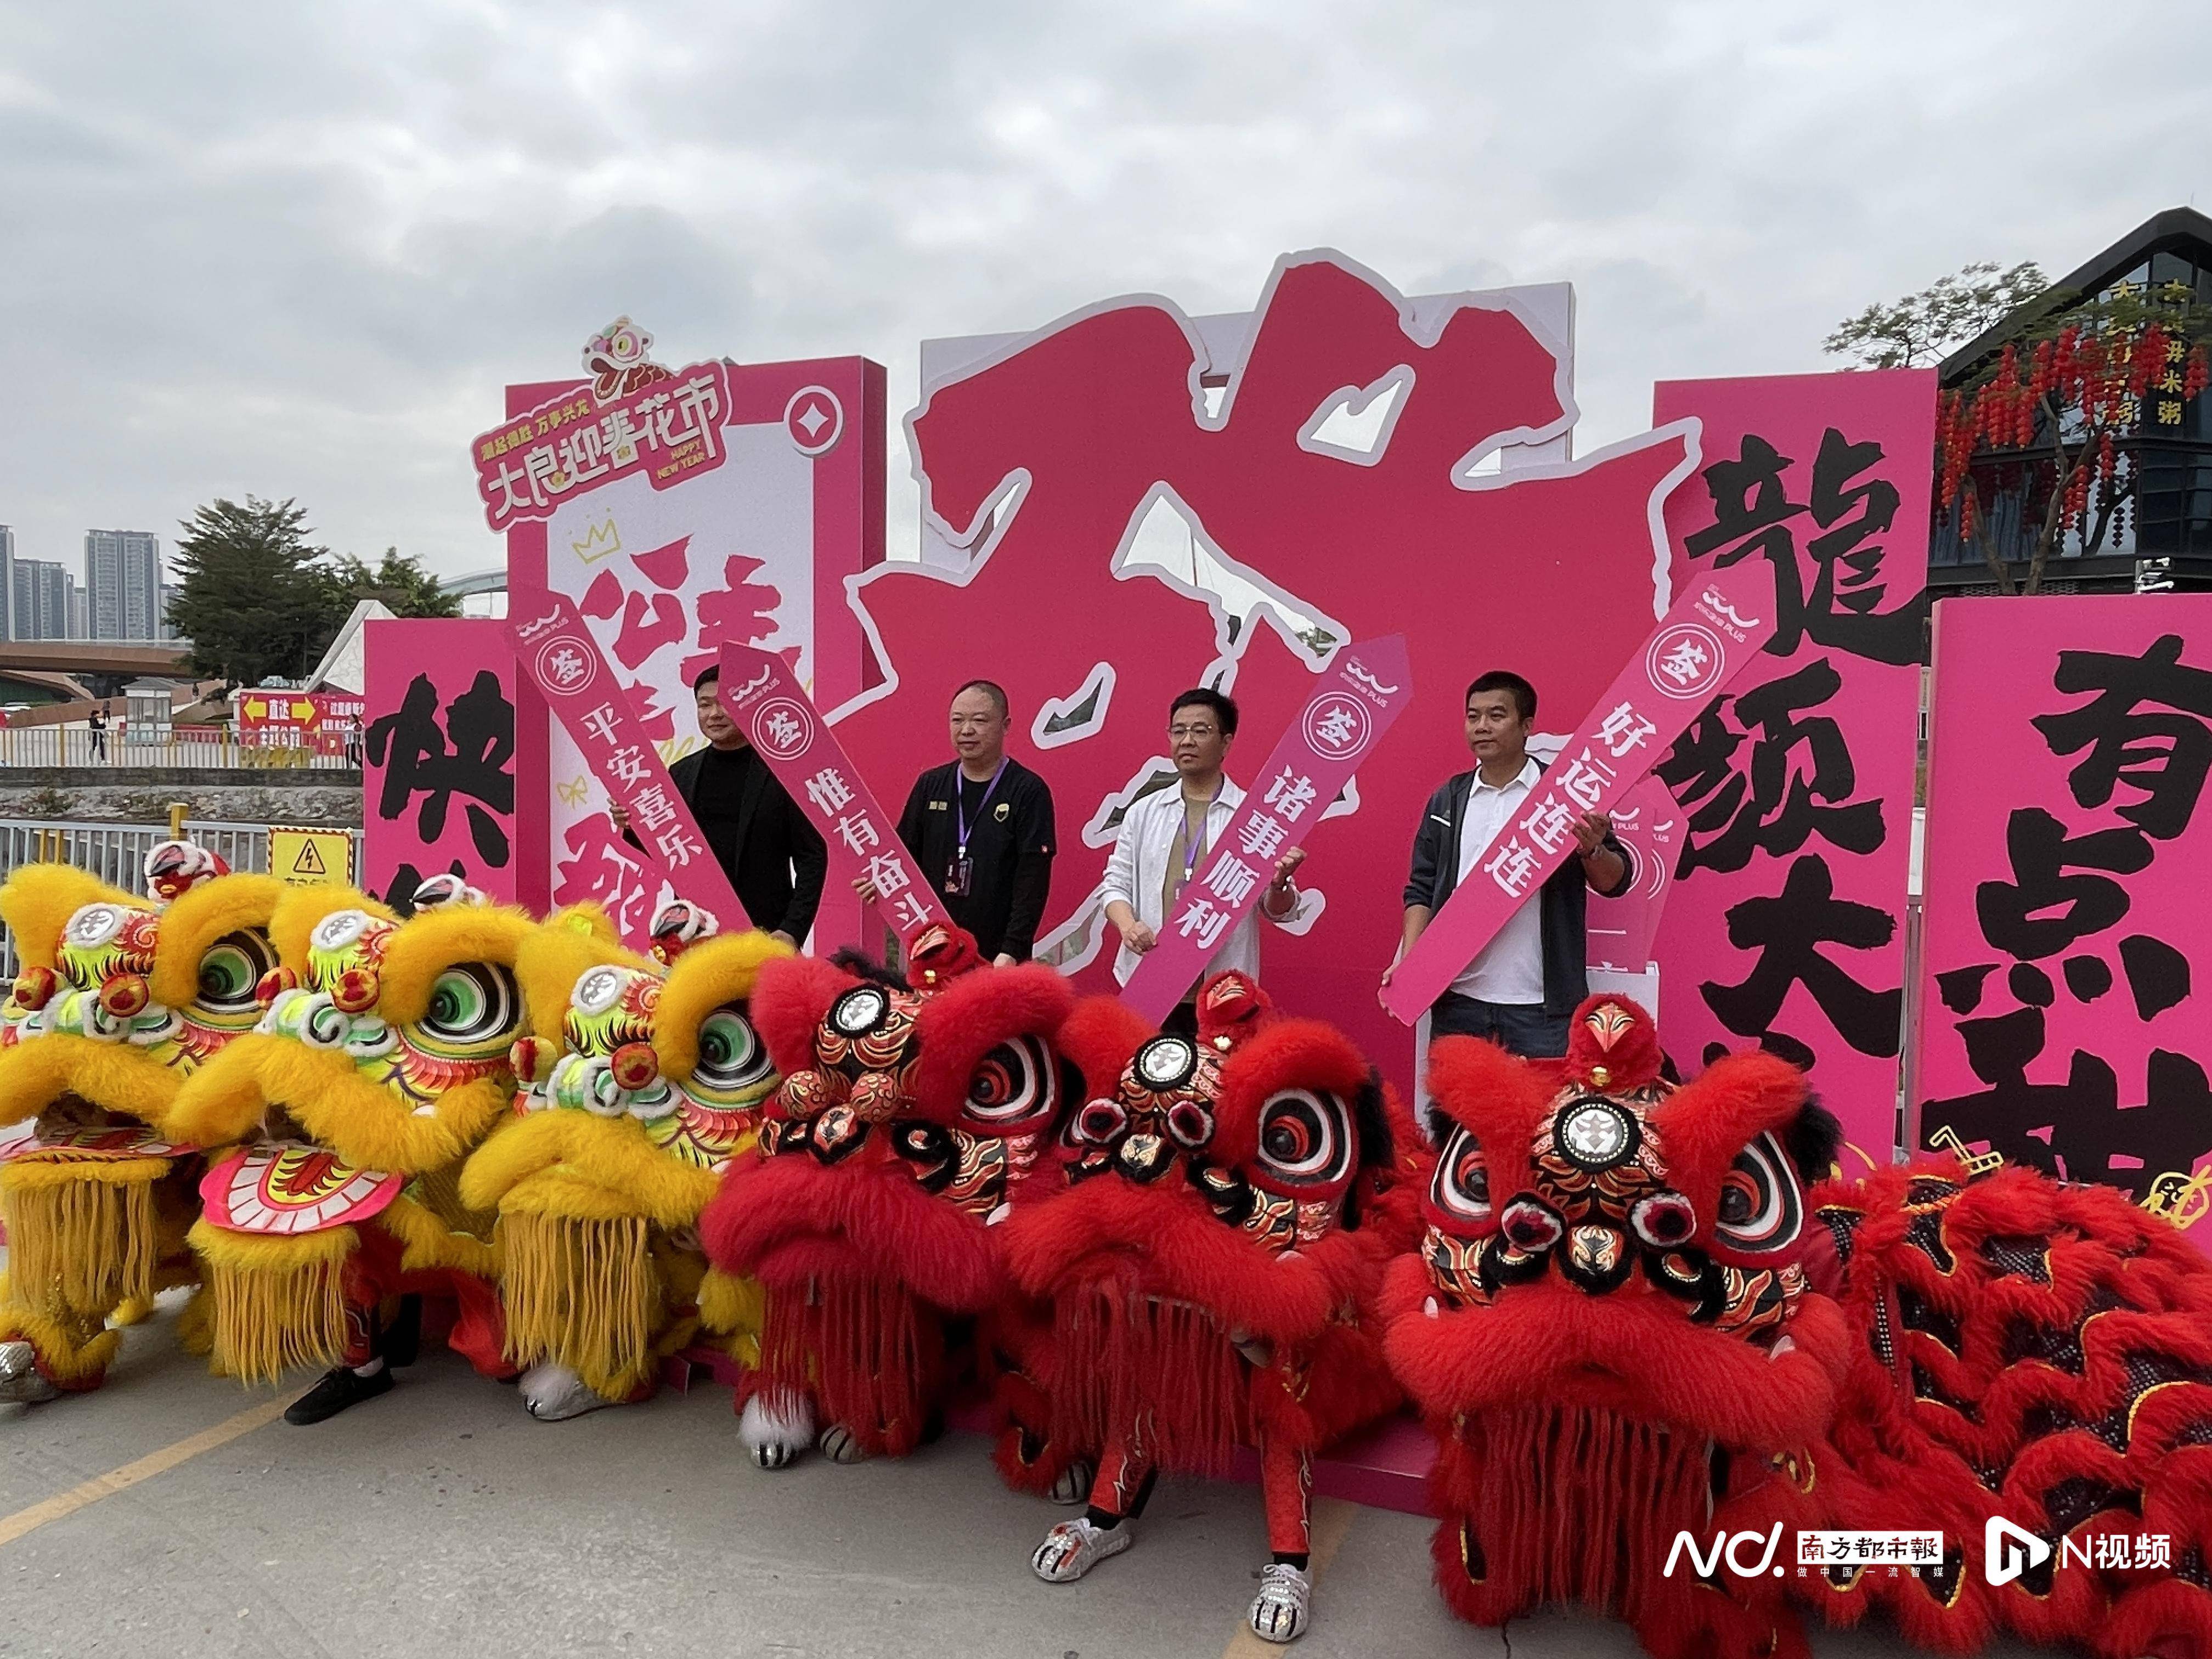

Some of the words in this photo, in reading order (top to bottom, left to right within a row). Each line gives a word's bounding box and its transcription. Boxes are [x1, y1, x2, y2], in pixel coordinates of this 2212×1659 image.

[489, 374, 719, 518] 大良迎春花市
[657, 462, 679, 479] NEW
[680, 452, 705, 468] YEAR
[670, 439, 701, 460] HAPPY
[579, 534, 801, 687] 公主
[1723, 623, 1747, 643] PLUS
[550, 649, 585, 685] 签
[1661, 637, 1708, 686] 签
[766, 711, 802, 748] 签
[1316, 706, 1358, 747] 签
[1651, 426, 1927, 1080] 龍颜大
[580, 701, 703, 871] 平安喜乐
[1483, 701, 1657, 898] 好运连连
[804, 768, 933, 931] 惟有奋斗
[1617, 822, 1639, 831] PLUS
[1174, 764, 1317, 950] 诸事顺利
